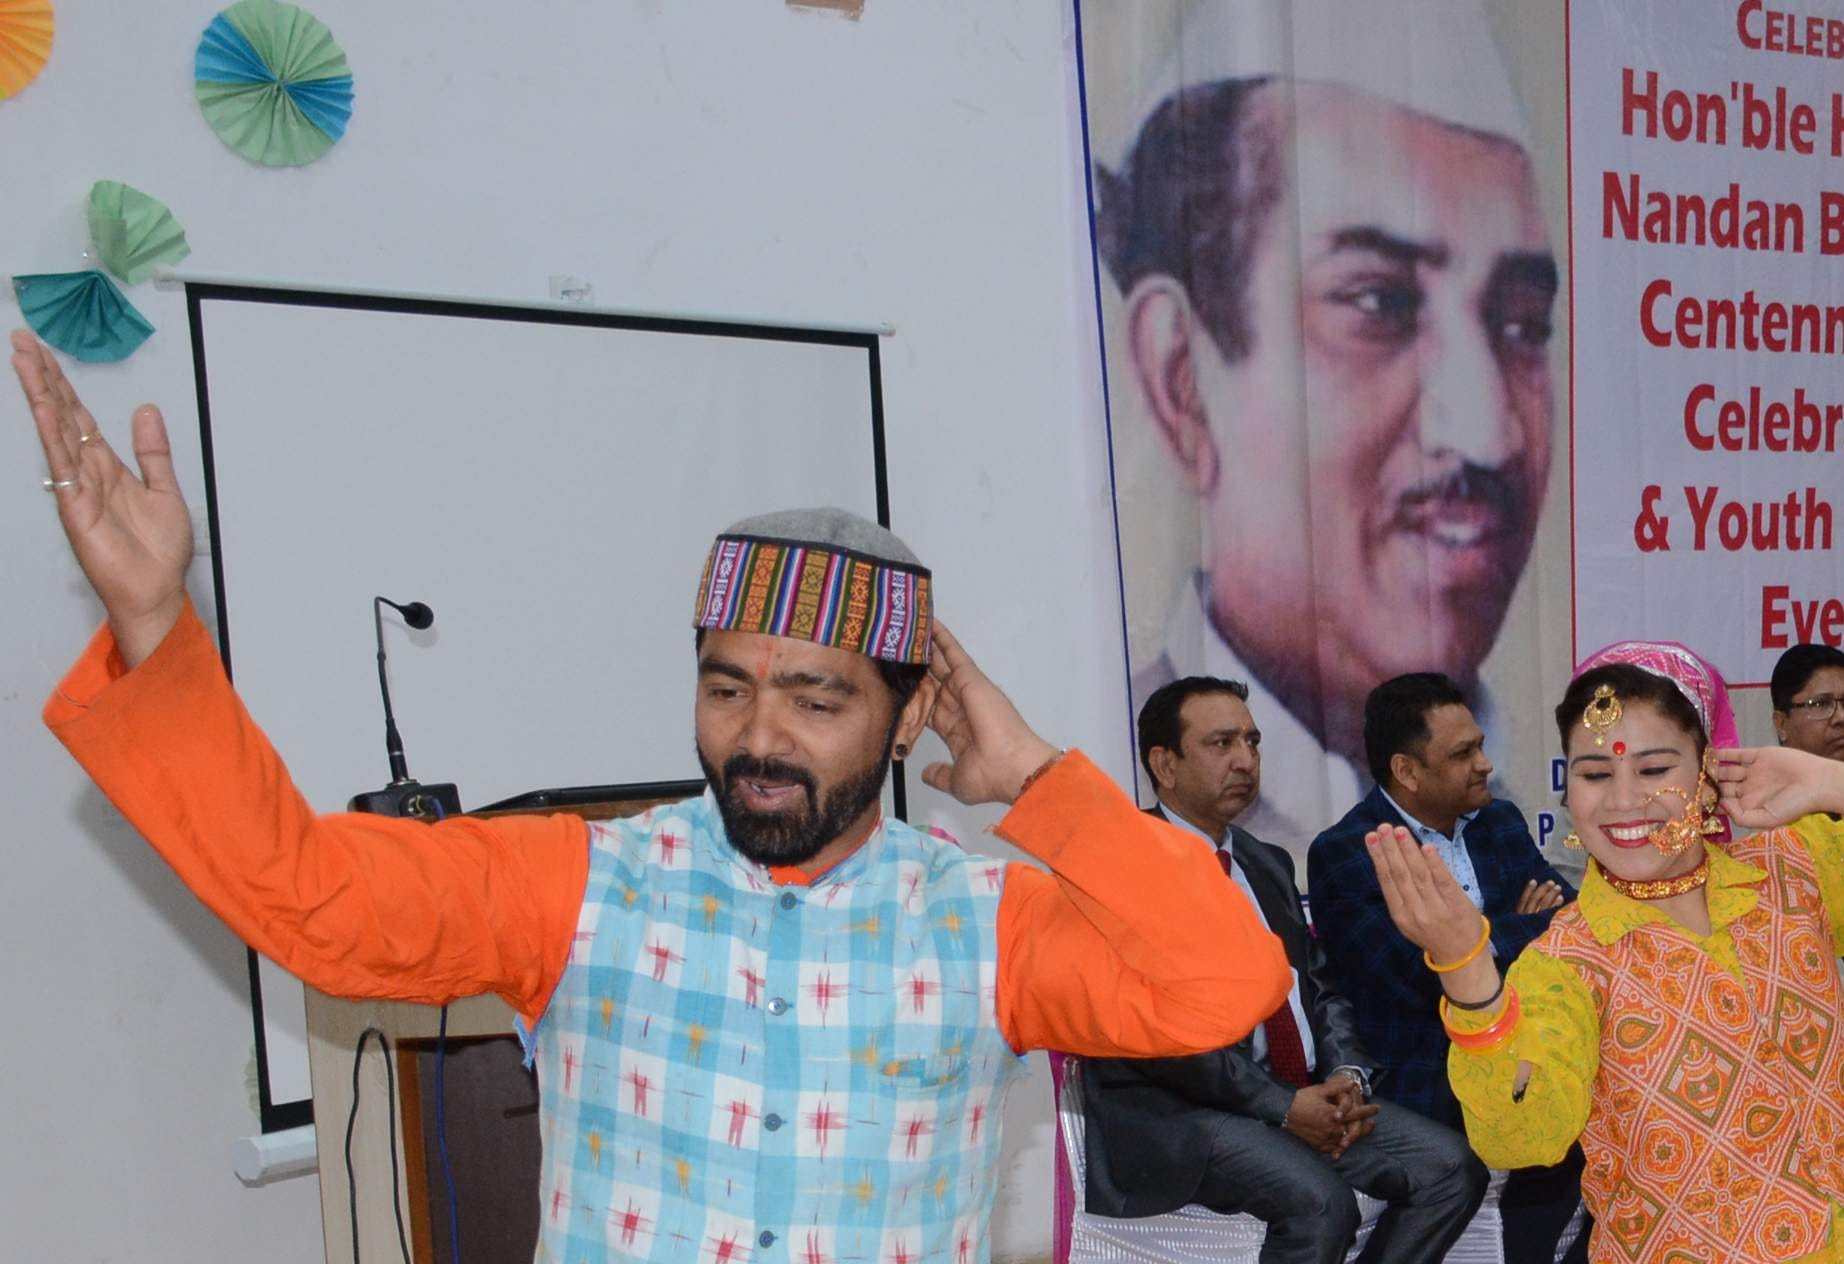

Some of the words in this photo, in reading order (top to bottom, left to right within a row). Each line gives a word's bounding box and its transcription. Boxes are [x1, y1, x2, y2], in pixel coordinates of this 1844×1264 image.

[1621, 67, 1817, 155] Hon'ble
[1602, 171, 1804, 253] Nandan
[1634, 484, 1671, 553] &
[1683, 486, 1833, 552] Youth
